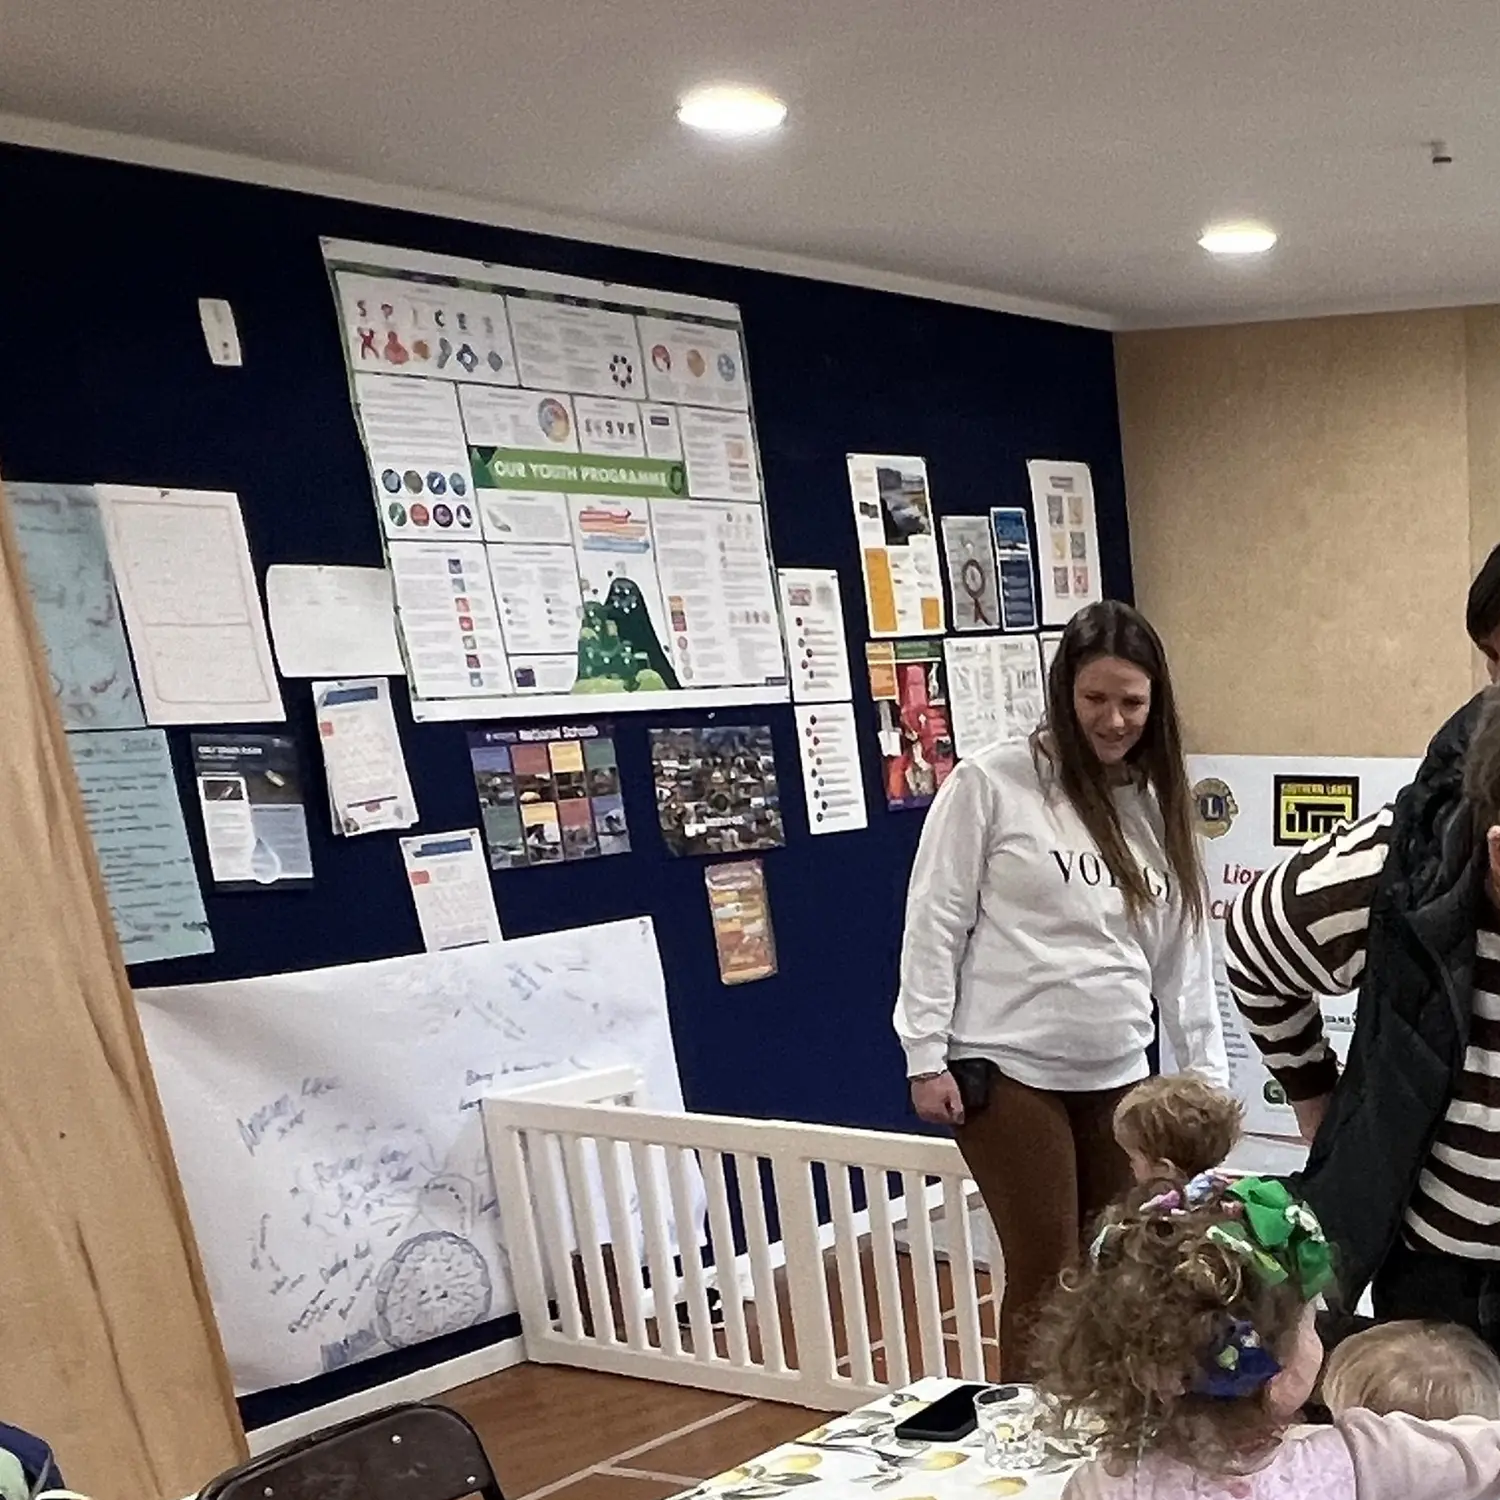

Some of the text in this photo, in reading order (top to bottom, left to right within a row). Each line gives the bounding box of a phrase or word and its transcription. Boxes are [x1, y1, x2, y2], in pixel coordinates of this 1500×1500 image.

[494, 460, 667, 487] OUR YOUTH PROGRAMME
